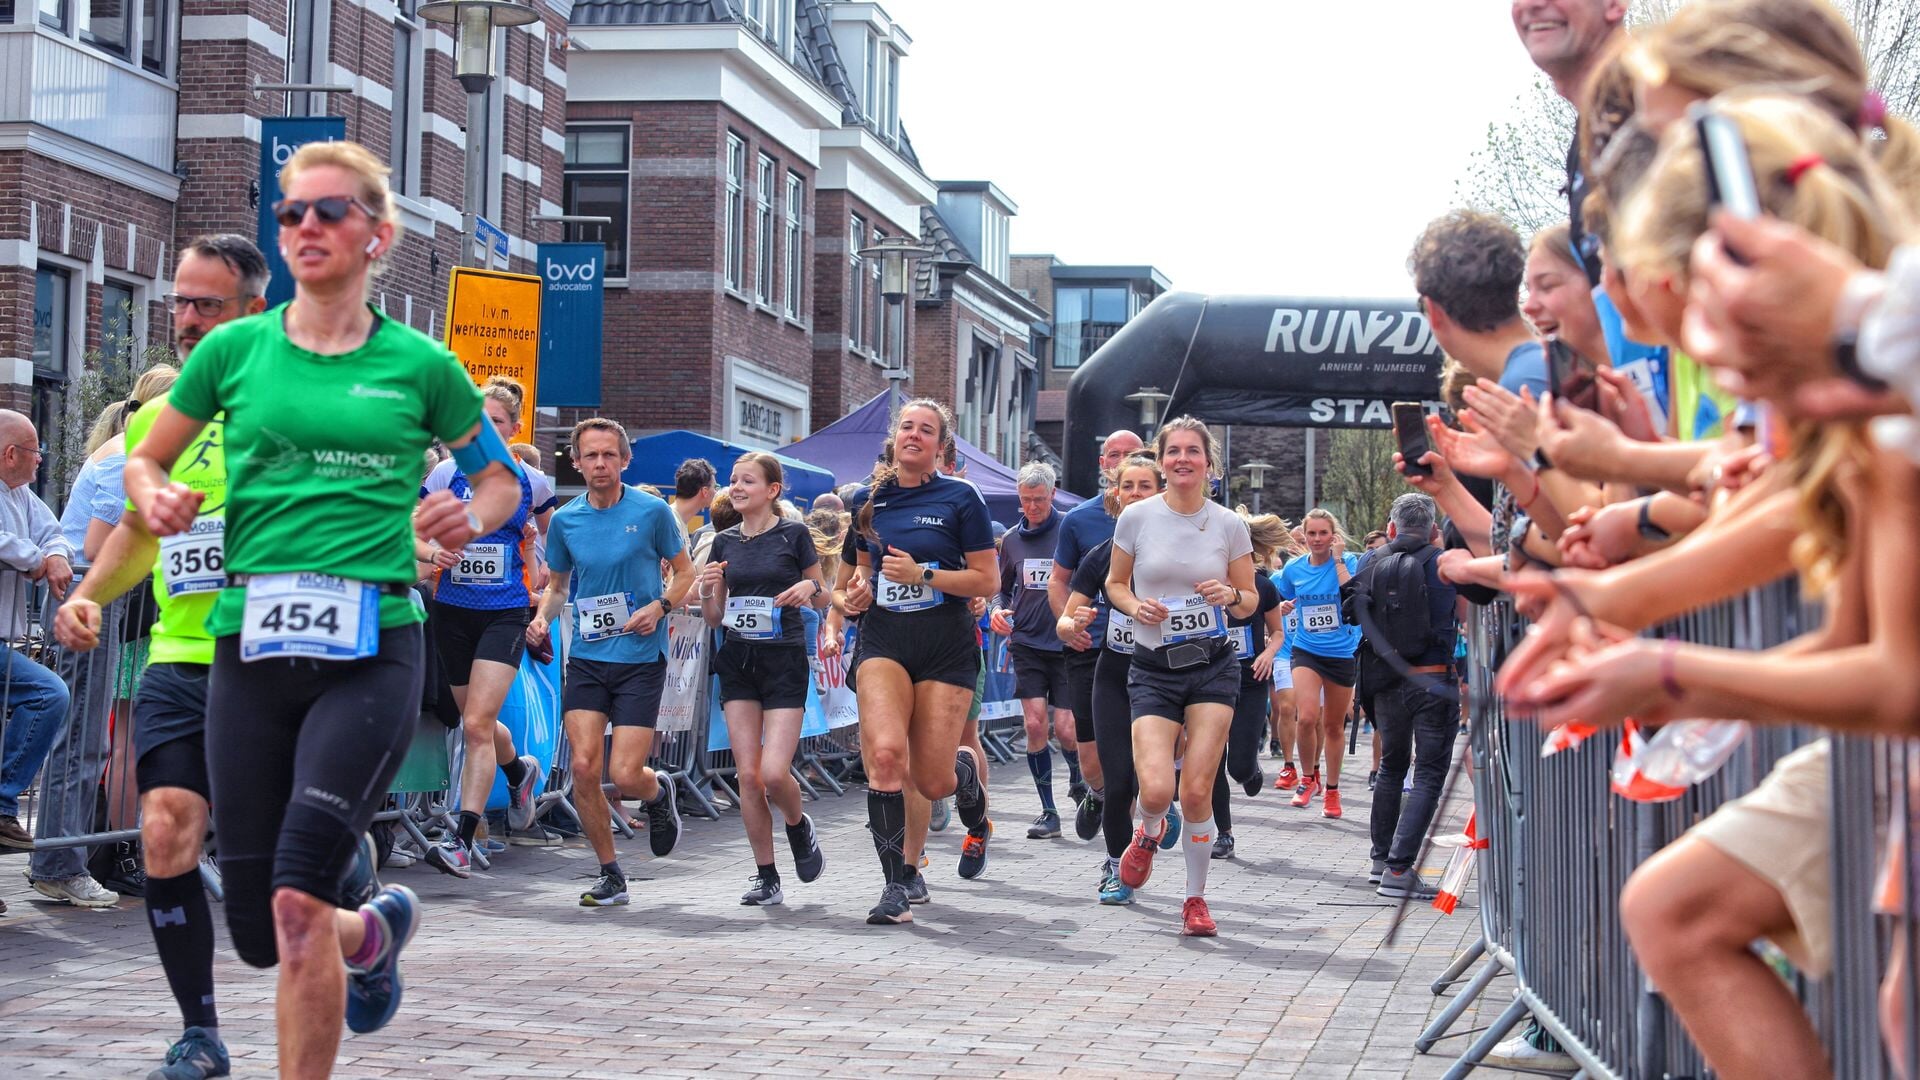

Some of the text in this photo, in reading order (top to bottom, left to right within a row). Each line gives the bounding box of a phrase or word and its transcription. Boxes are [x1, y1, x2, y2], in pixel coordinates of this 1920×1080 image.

[546, 257, 596, 281] bvd
[549, 283, 592, 291] advocaten
[455, 323, 536, 340] werkzaamheden
[484, 343, 507, 357] is de
[464, 360, 524, 378] Kampstraat
[1319, 363, 1362, 372] ARNHEM
[1373, 364, 1426, 373] NIJMEGEN
[1309, 398, 1449, 424] STAT
[312, 449, 397, 468] VATHORST
[921, 516, 944, 525] FALK
[170, 547, 224, 577] 356
[460, 560, 496, 575] 866
[597, 596, 619, 605] MOBA
[886, 584, 924, 602] 529
[260, 602, 340, 635] 454
[593, 612, 616, 629] 56
[734, 613, 757, 628] 55
[1170, 611, 1210, 631] 530
[1309, 615, 1333, 627] 839
